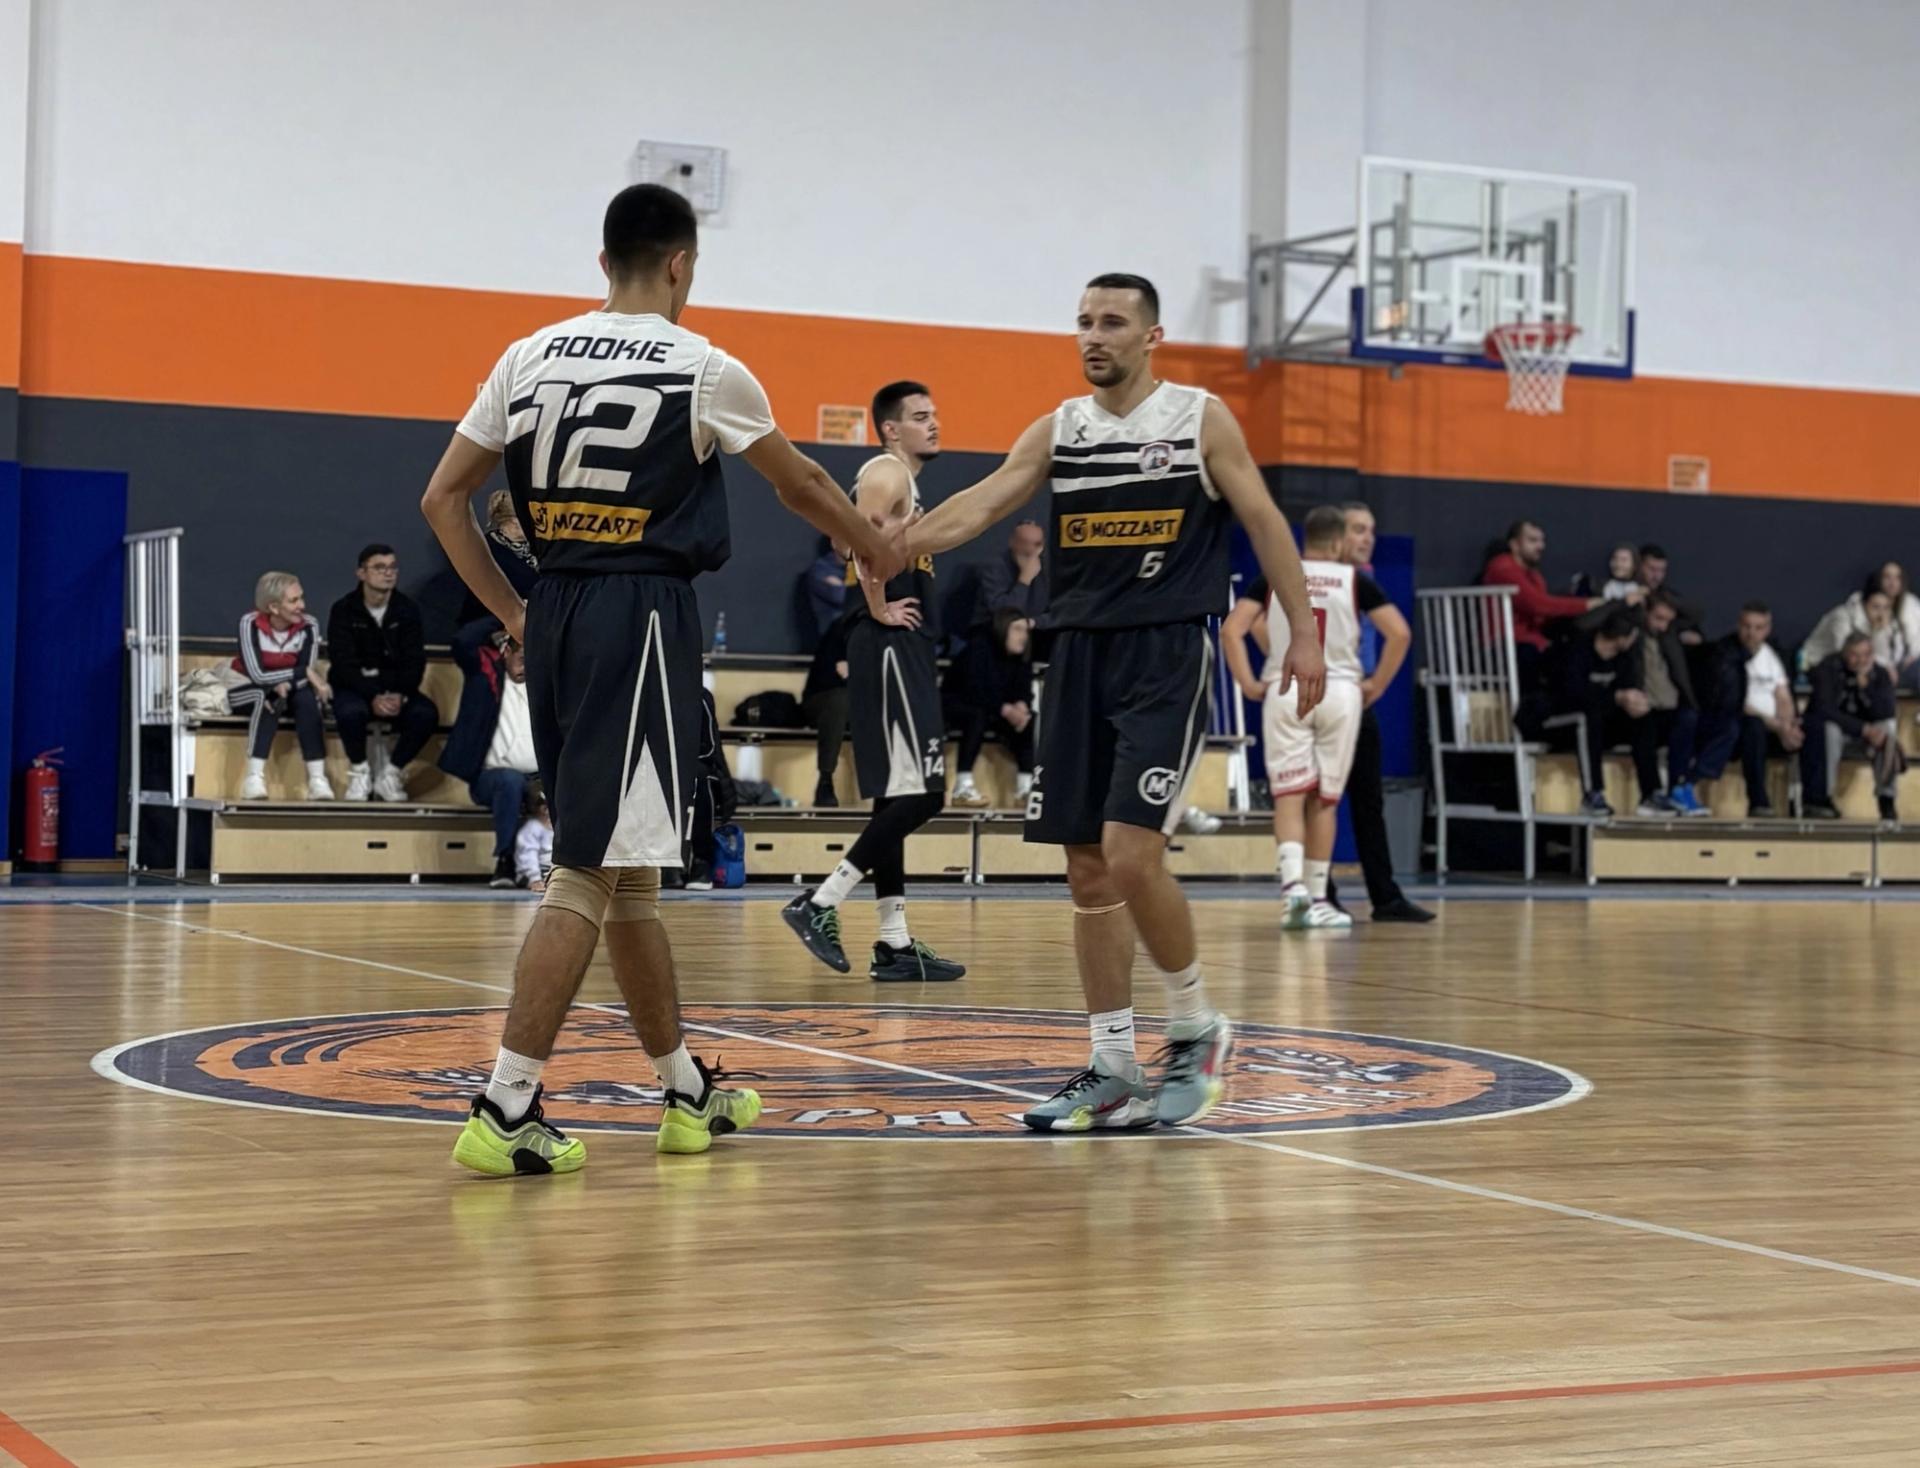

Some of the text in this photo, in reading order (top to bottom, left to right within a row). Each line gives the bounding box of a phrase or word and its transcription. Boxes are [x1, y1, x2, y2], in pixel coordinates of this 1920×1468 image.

[544, 336, 674, 363] ROOKIE
[531, 382, 664, 492] 12
[1090, 519, 1176, 538] MOZZART
[1137, 551, 1165, 578] 6
[924, 756, 945, 777] 14
[1027, 791, 1043, 820] 6
